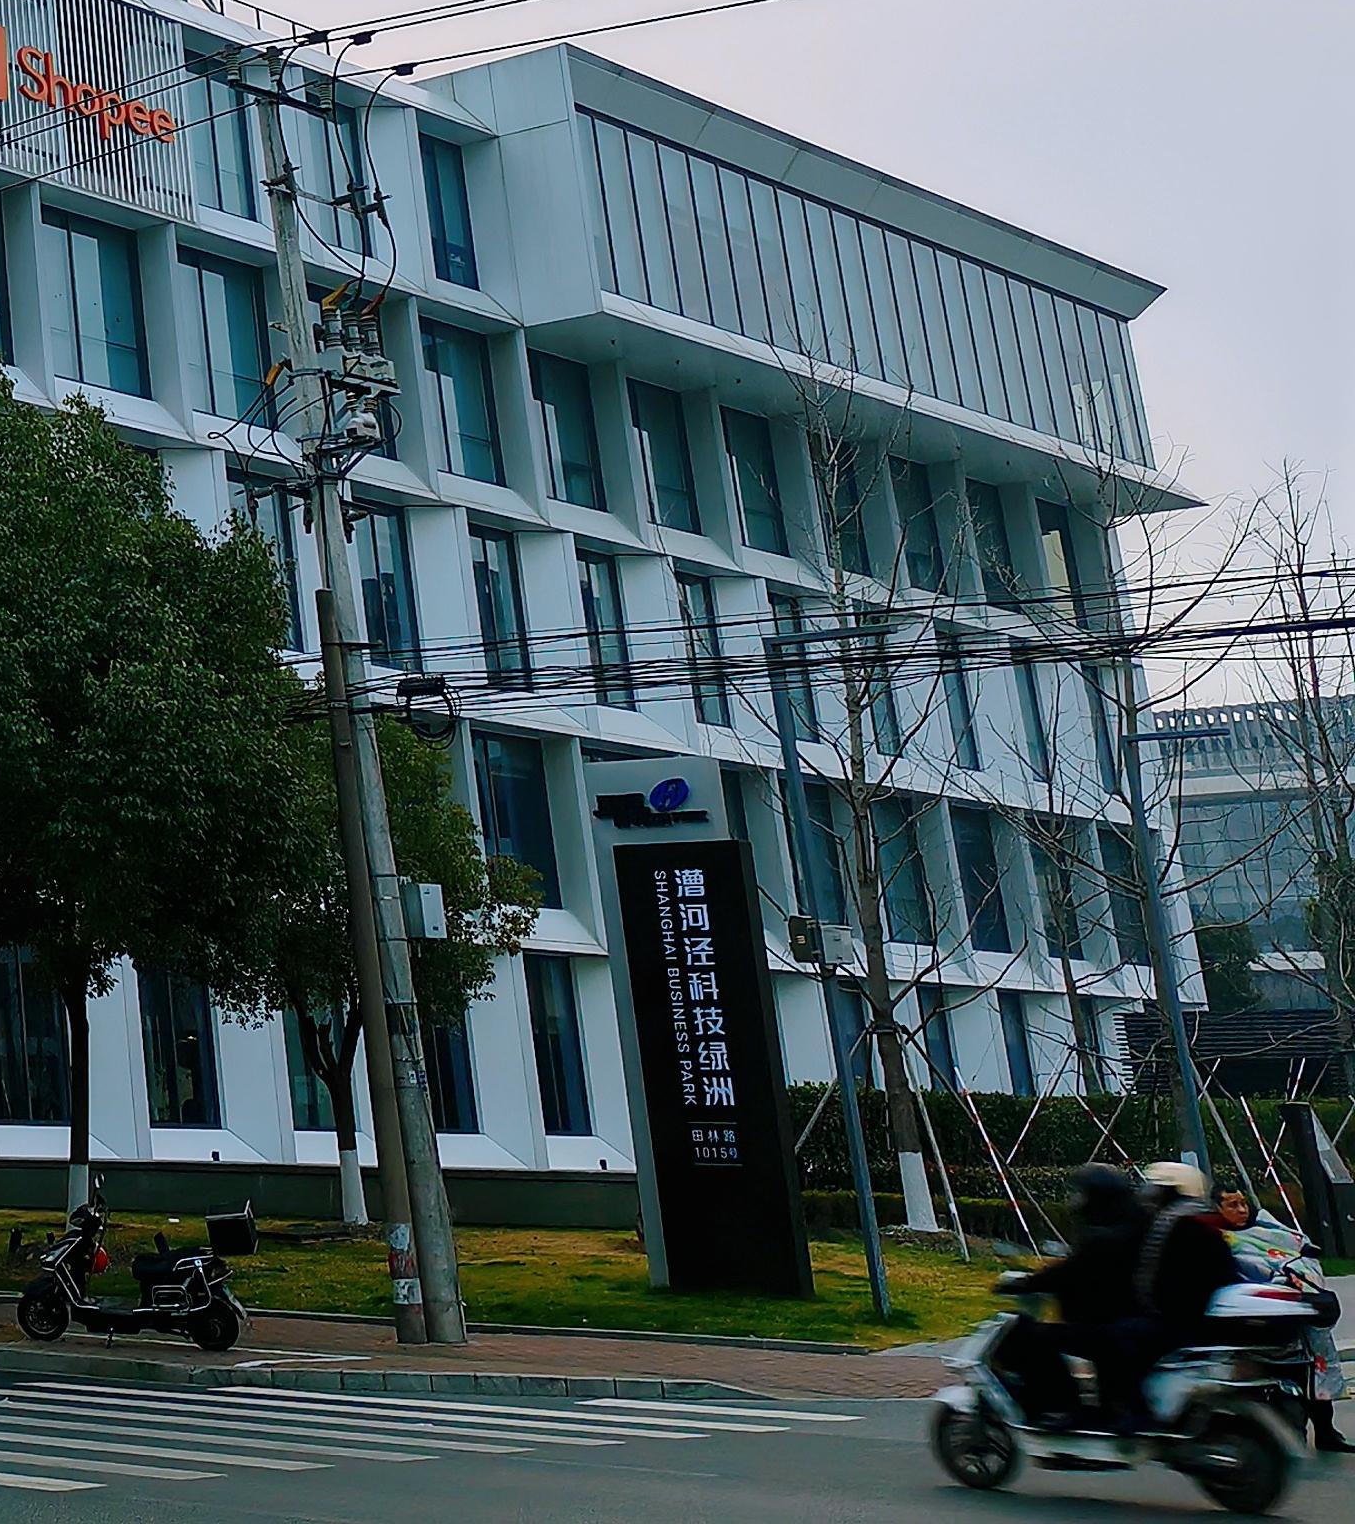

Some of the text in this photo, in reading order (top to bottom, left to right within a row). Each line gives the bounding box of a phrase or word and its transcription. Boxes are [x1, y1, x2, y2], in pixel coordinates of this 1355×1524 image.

[16, 45, 176, 143] Shopee
[654, 870, 697, 1105] SHANGHAI BUSINESS PARK
[673, 868, 735, 1106] 漕河泾科技绿洲
